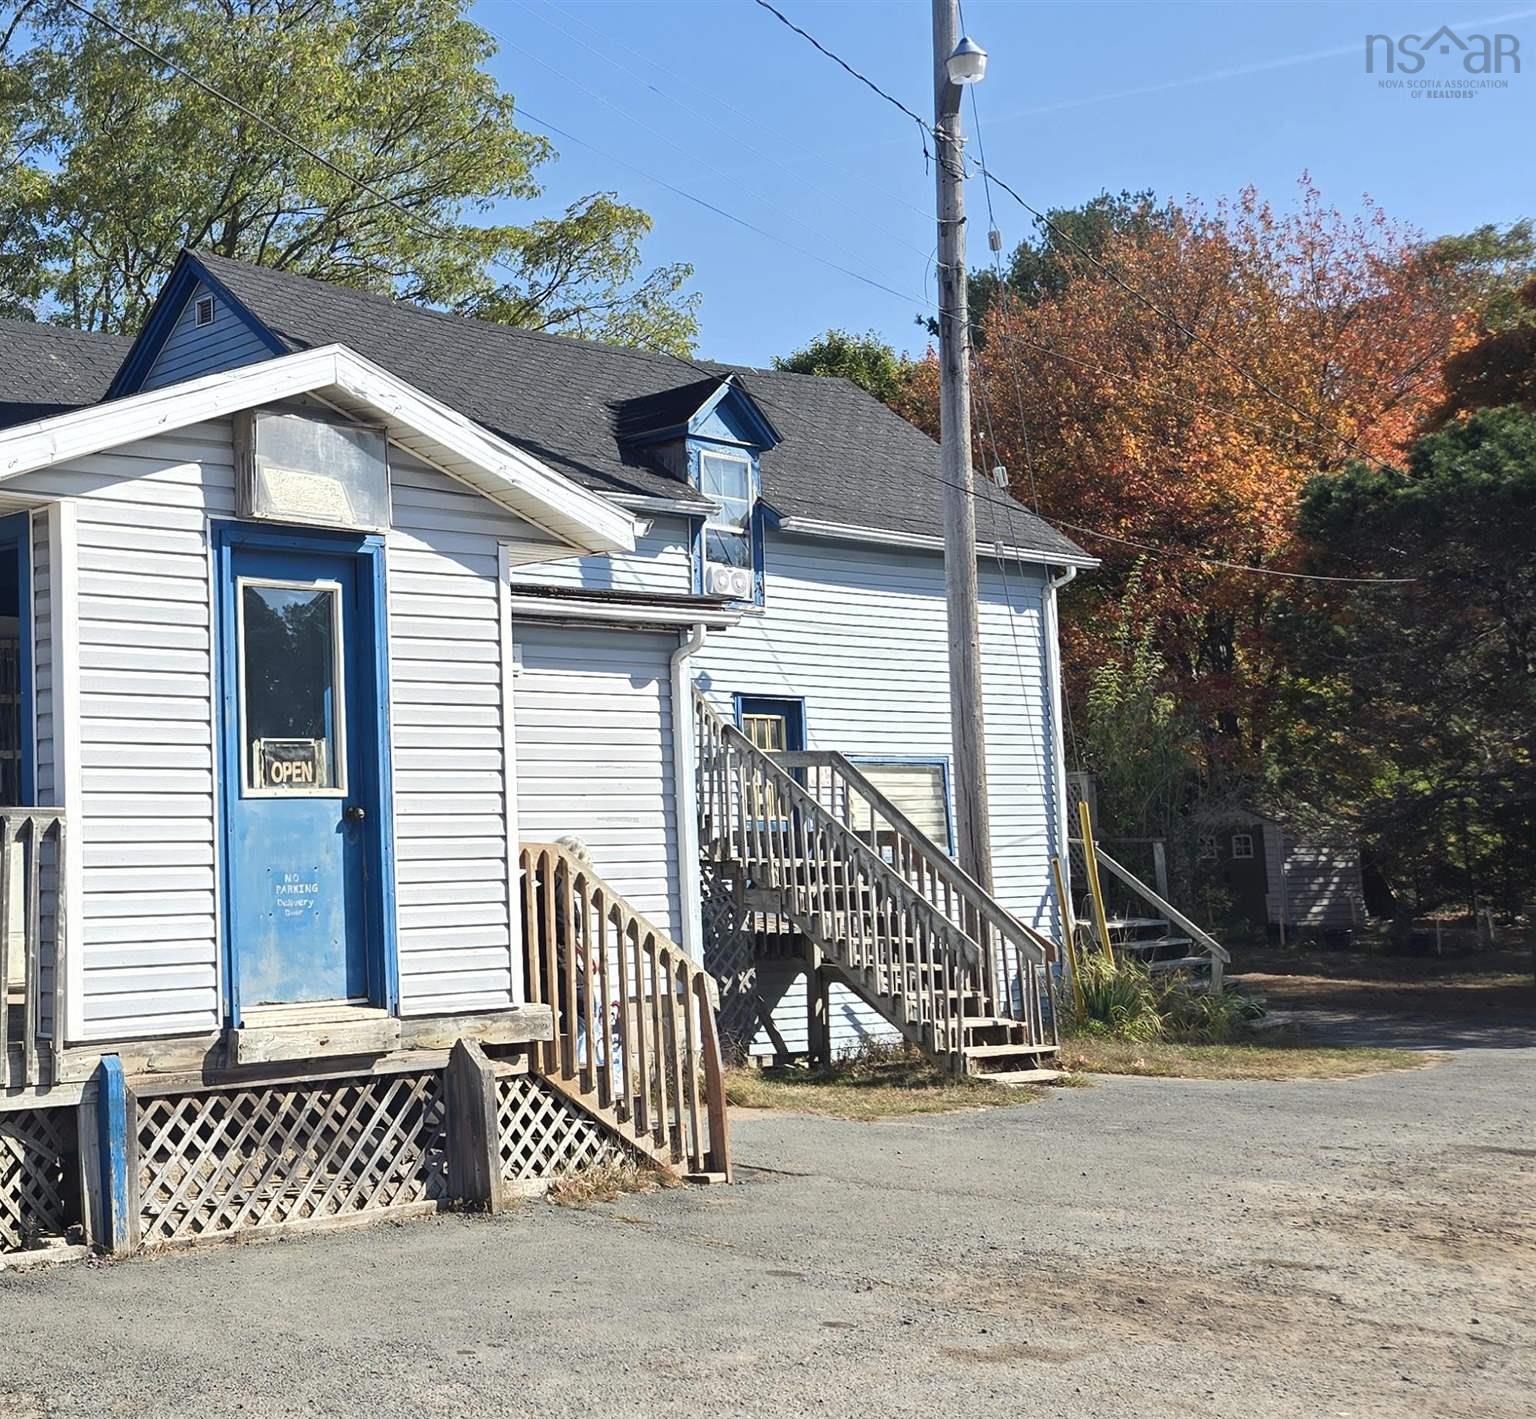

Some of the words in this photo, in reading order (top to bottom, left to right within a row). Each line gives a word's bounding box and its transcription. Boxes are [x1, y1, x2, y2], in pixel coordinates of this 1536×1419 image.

[271, 761, 312, 782] OPEN
[284, 873, 300, 882] NO
[275, 883, 319, 894] PARKING
